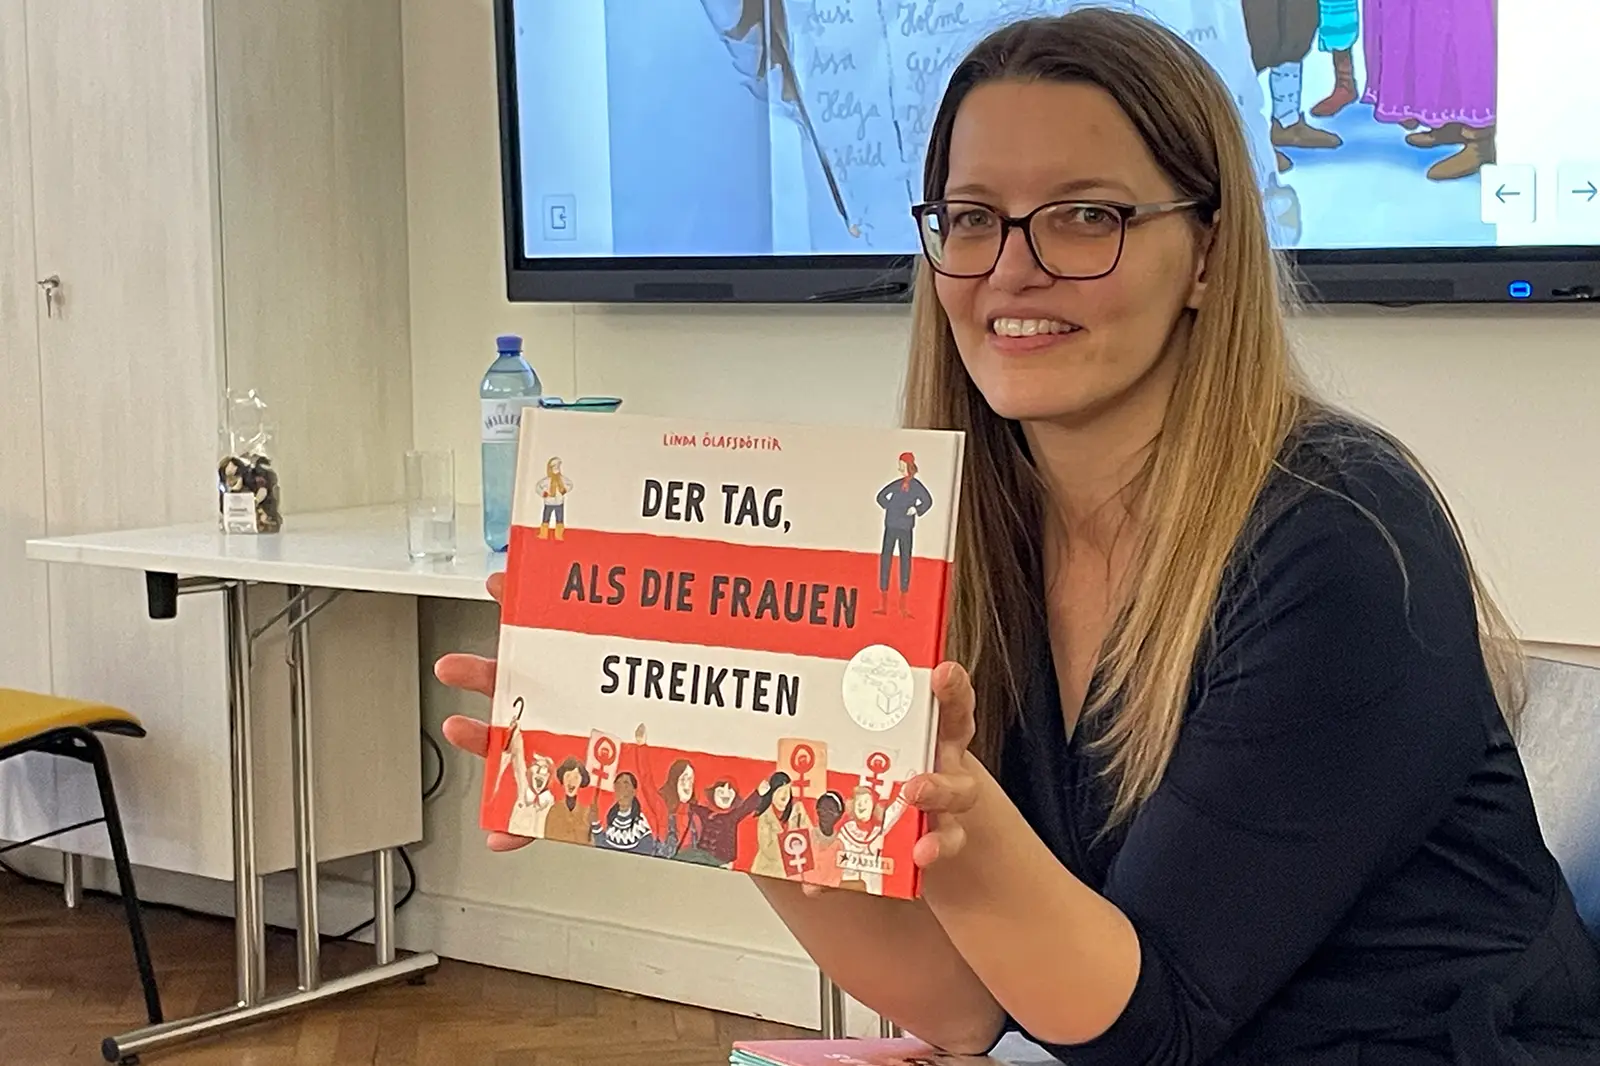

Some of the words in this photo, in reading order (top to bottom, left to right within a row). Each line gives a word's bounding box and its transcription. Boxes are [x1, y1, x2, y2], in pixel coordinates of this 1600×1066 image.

[817, 90, 881, 141] Helga
[642, 479, 704, 523] DER
[721, 484, 791, 533] TAG,
[562, 562, 626, 605] ALS
[641, 568, 695, 612] DIE
[710, 575, 858, 629] FRAUEN
[600, 655, 800, 716] STREIKTEN
